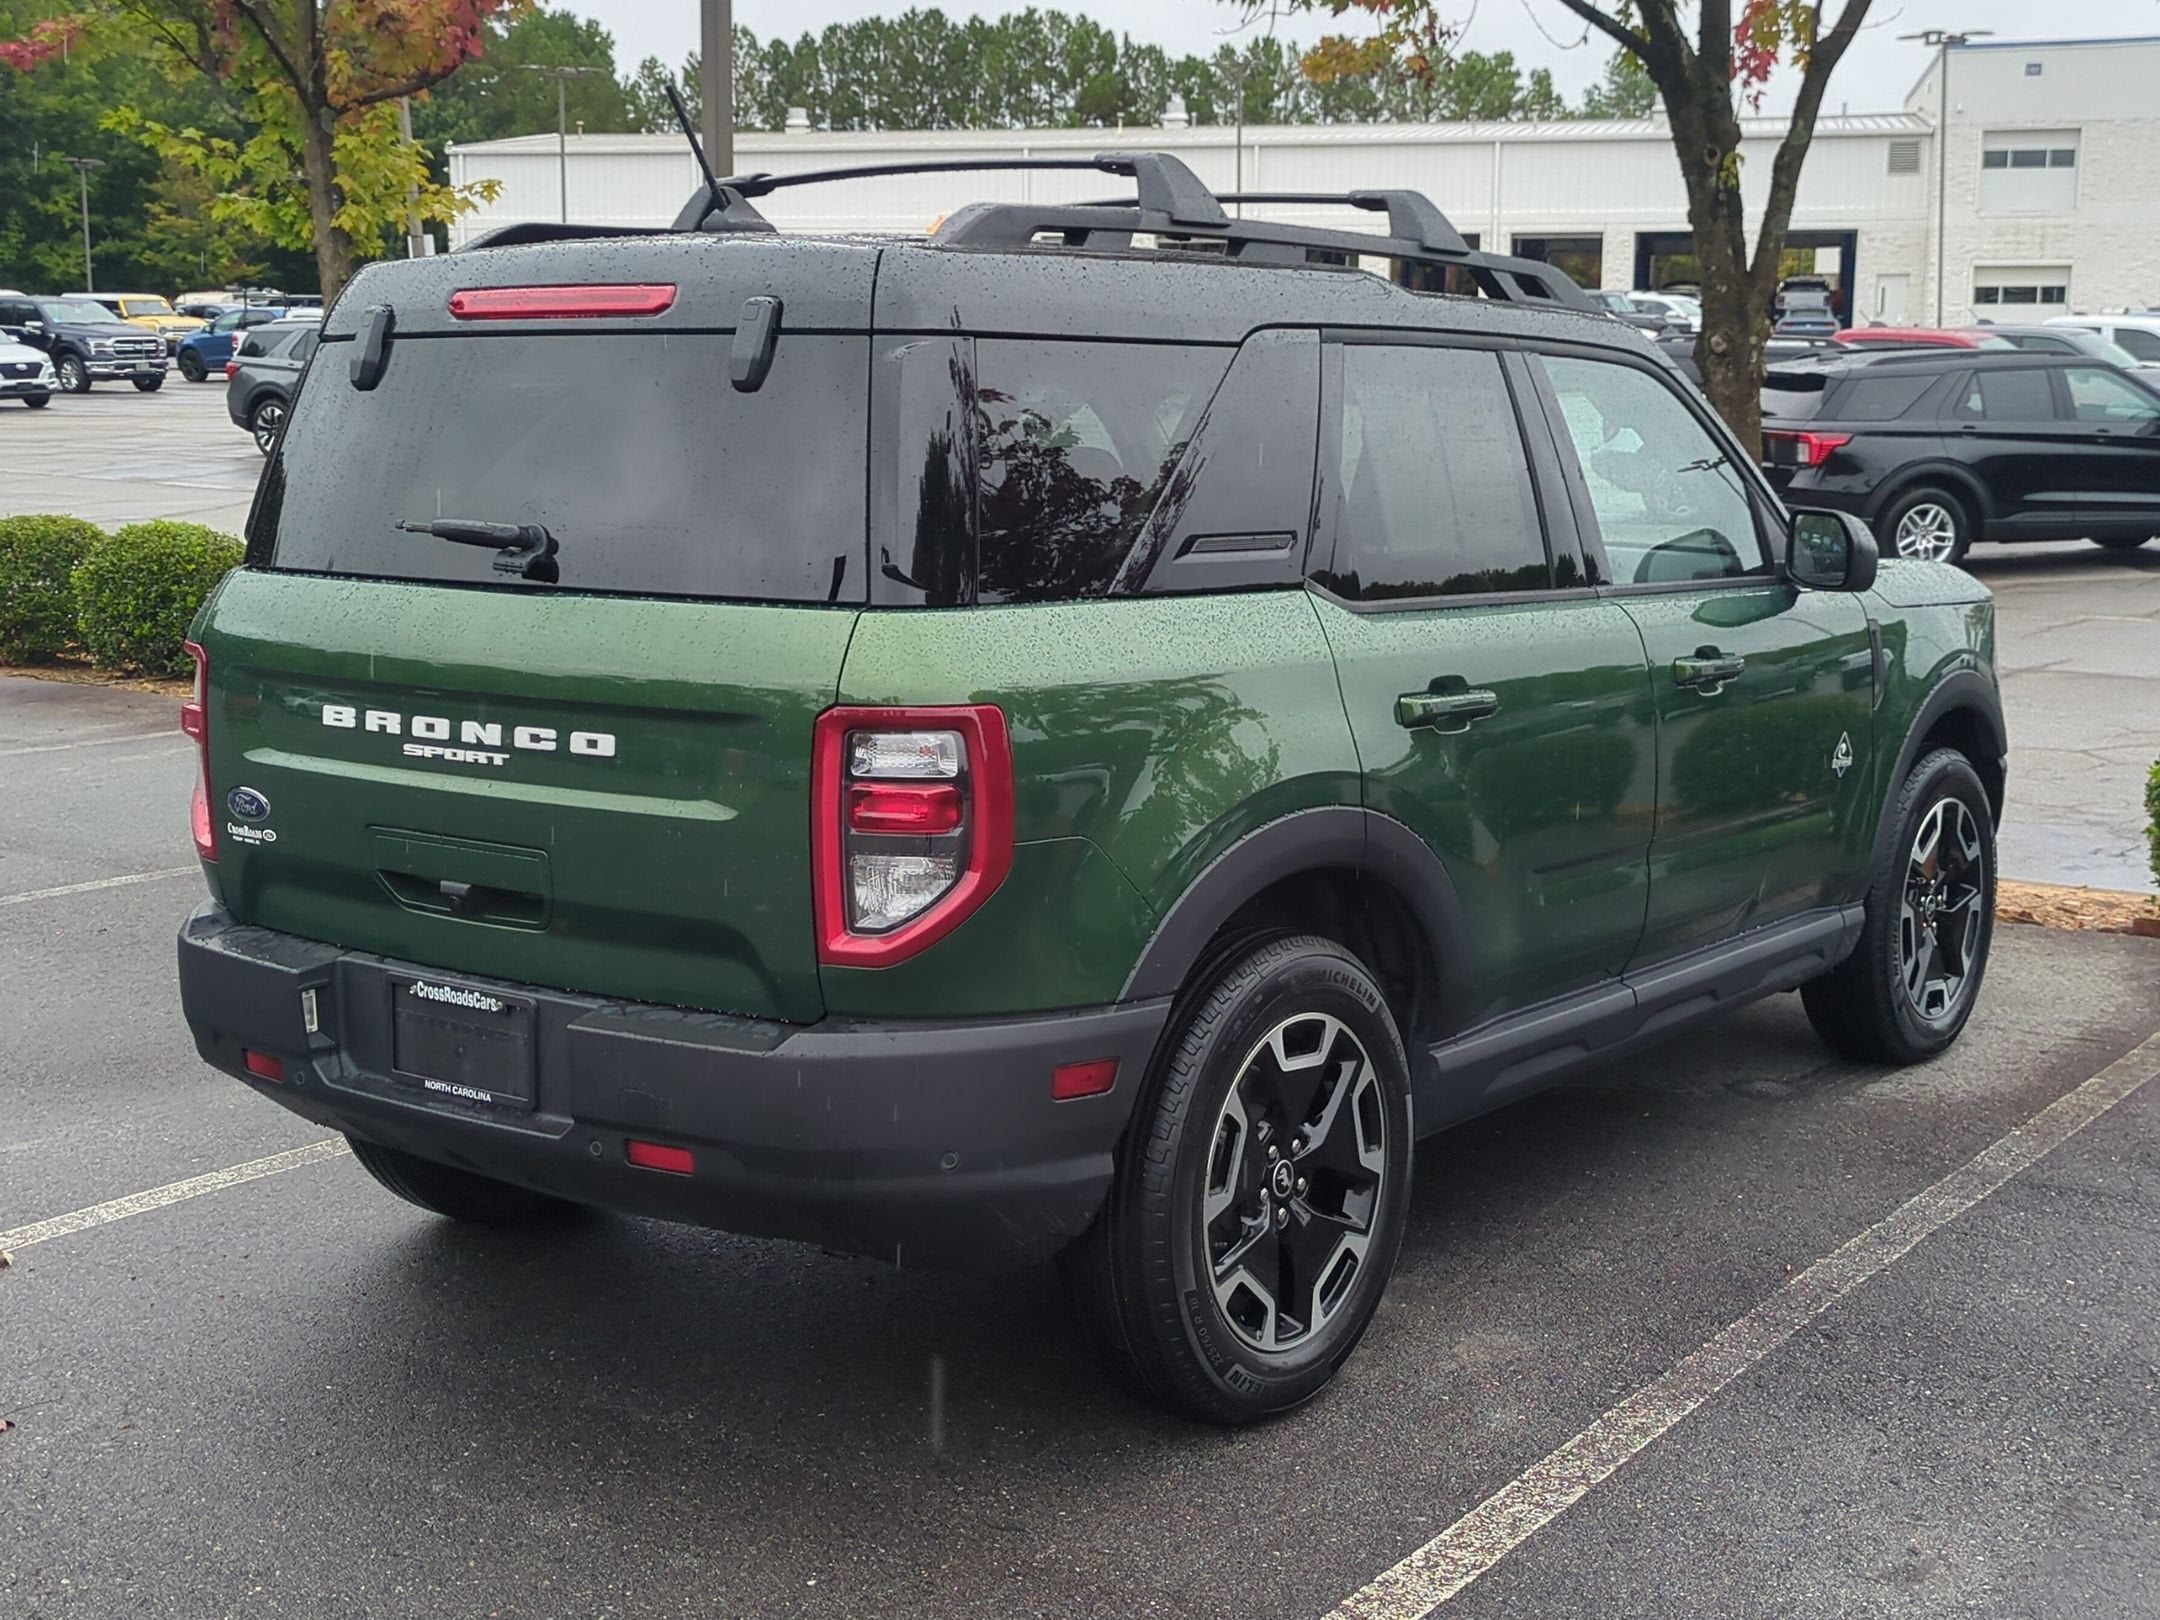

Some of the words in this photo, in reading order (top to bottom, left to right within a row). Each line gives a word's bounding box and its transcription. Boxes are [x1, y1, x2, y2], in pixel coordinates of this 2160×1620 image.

[322, 704, 616, 757] BRONCO
[402, 743, 511, 766] SPORT
[416, 980, 498, 1012] CrossRoadsCars
[424, 1079, 451, 1093] NORTH
[451, 1085, 491, 1102] CAROLINA
